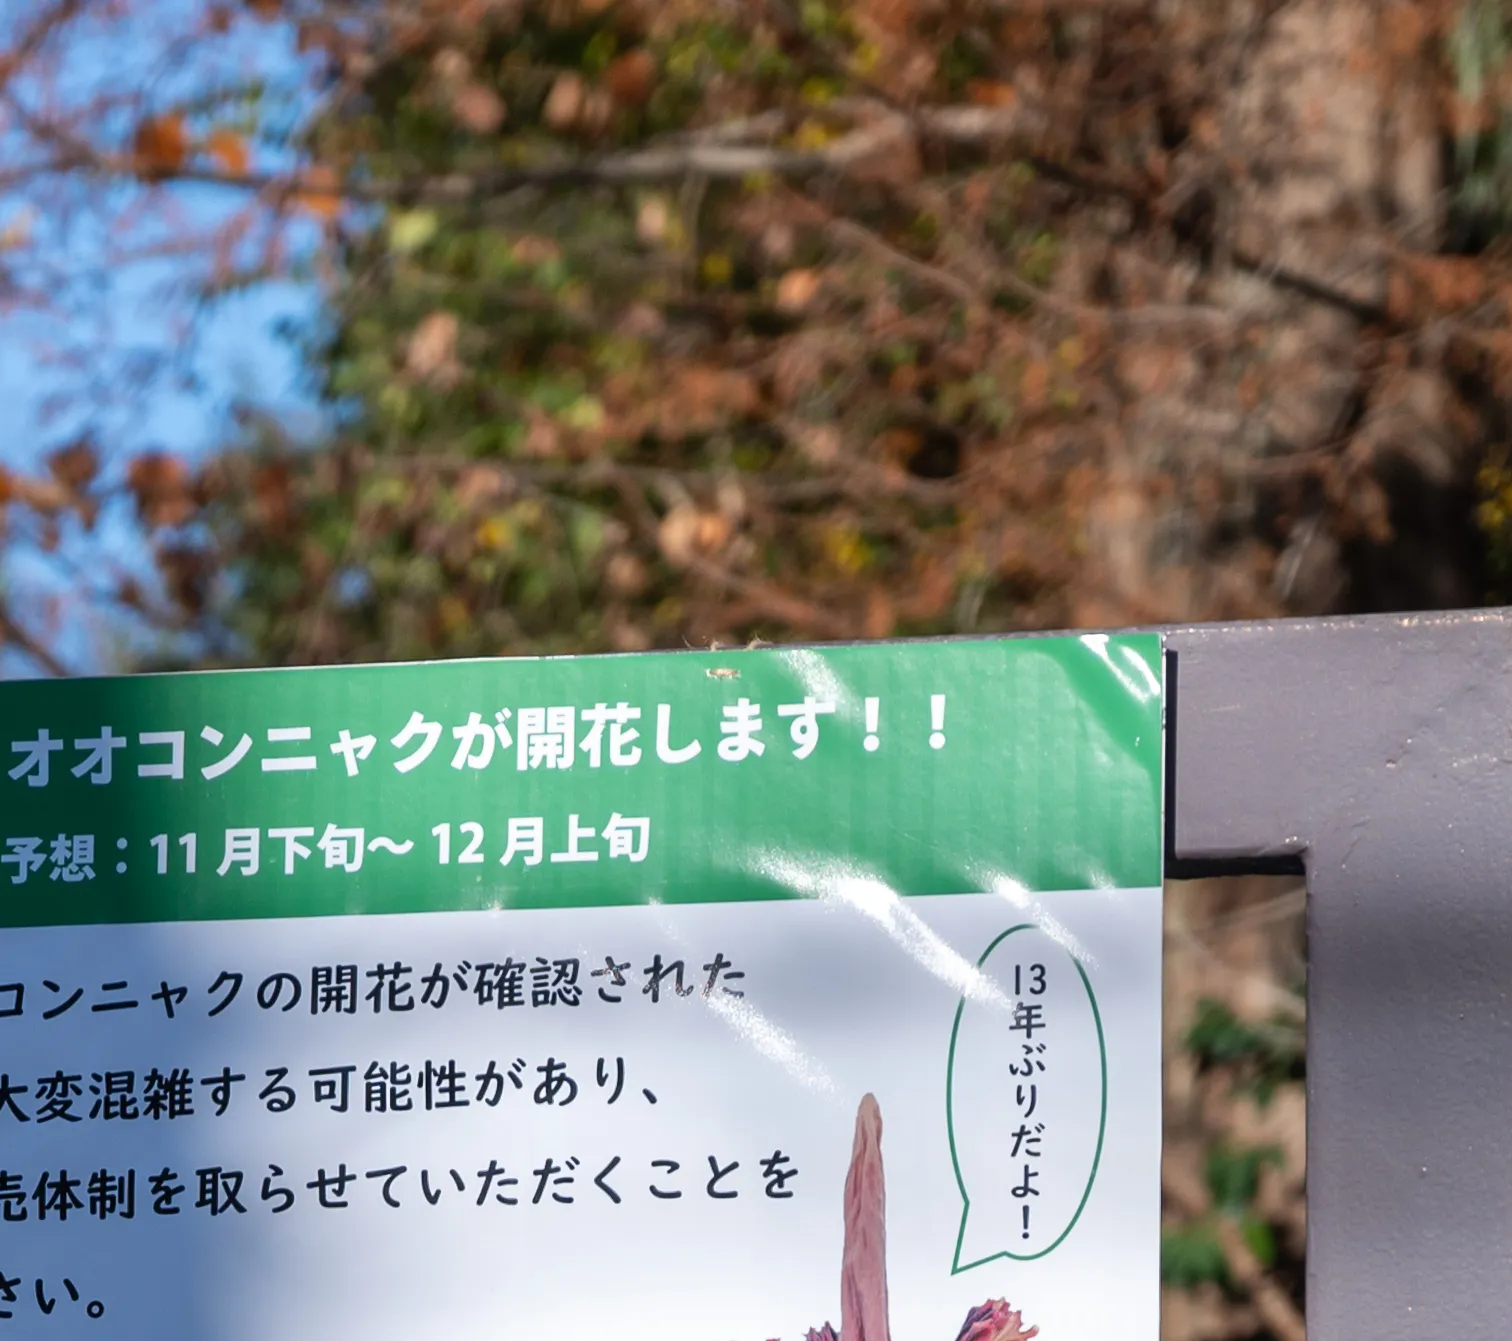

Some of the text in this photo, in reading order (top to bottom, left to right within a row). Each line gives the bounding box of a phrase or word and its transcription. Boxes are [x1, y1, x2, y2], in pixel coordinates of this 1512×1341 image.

[1007, 962, 1048, 1241] 13年ぶりだよ！
